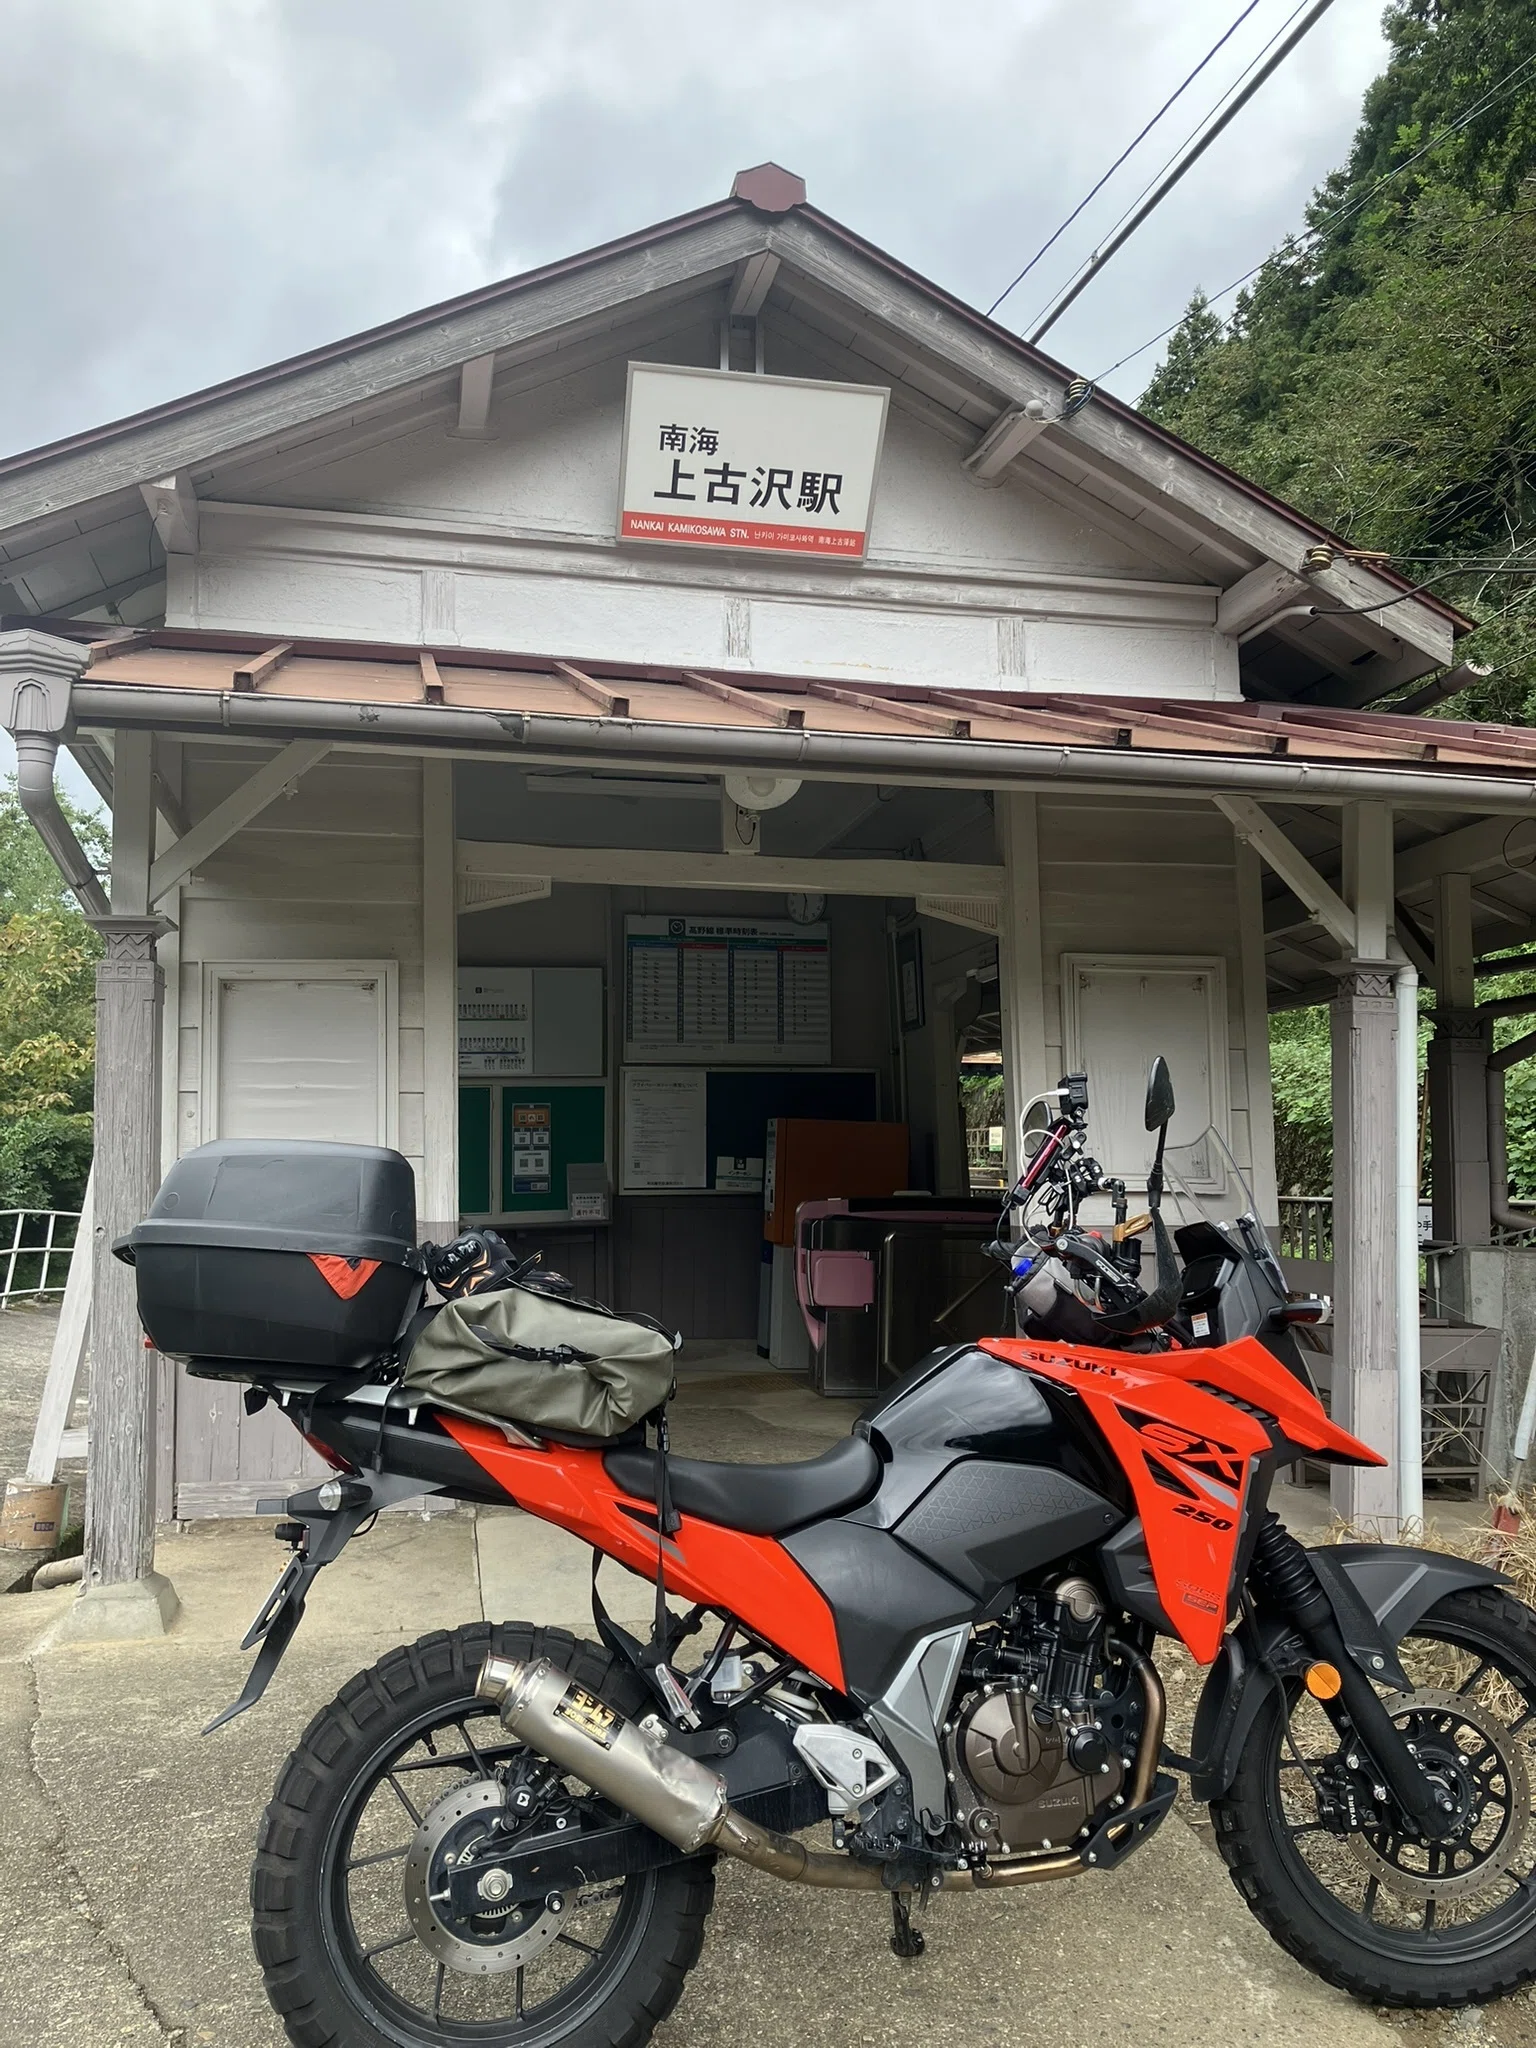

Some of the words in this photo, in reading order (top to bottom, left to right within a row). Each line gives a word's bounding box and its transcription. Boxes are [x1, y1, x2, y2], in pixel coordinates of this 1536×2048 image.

[659, 423, 719, 456] 南海
[653, 459, 843, 515] 上古沢駅
[630, 519, 664, 531] NANKAI
[667, 522, 726, 537] KAMIKOSAWA
[729, 527, 750, 539] STN.
[1021, 1350, 1118, 1377] SUZUKI
[1172, 1503, 1234, 1531] 250
[571, 1690, 616, 1728] ヨシムラ
[1038, 1796, 1079, 1809] SUZUKI
